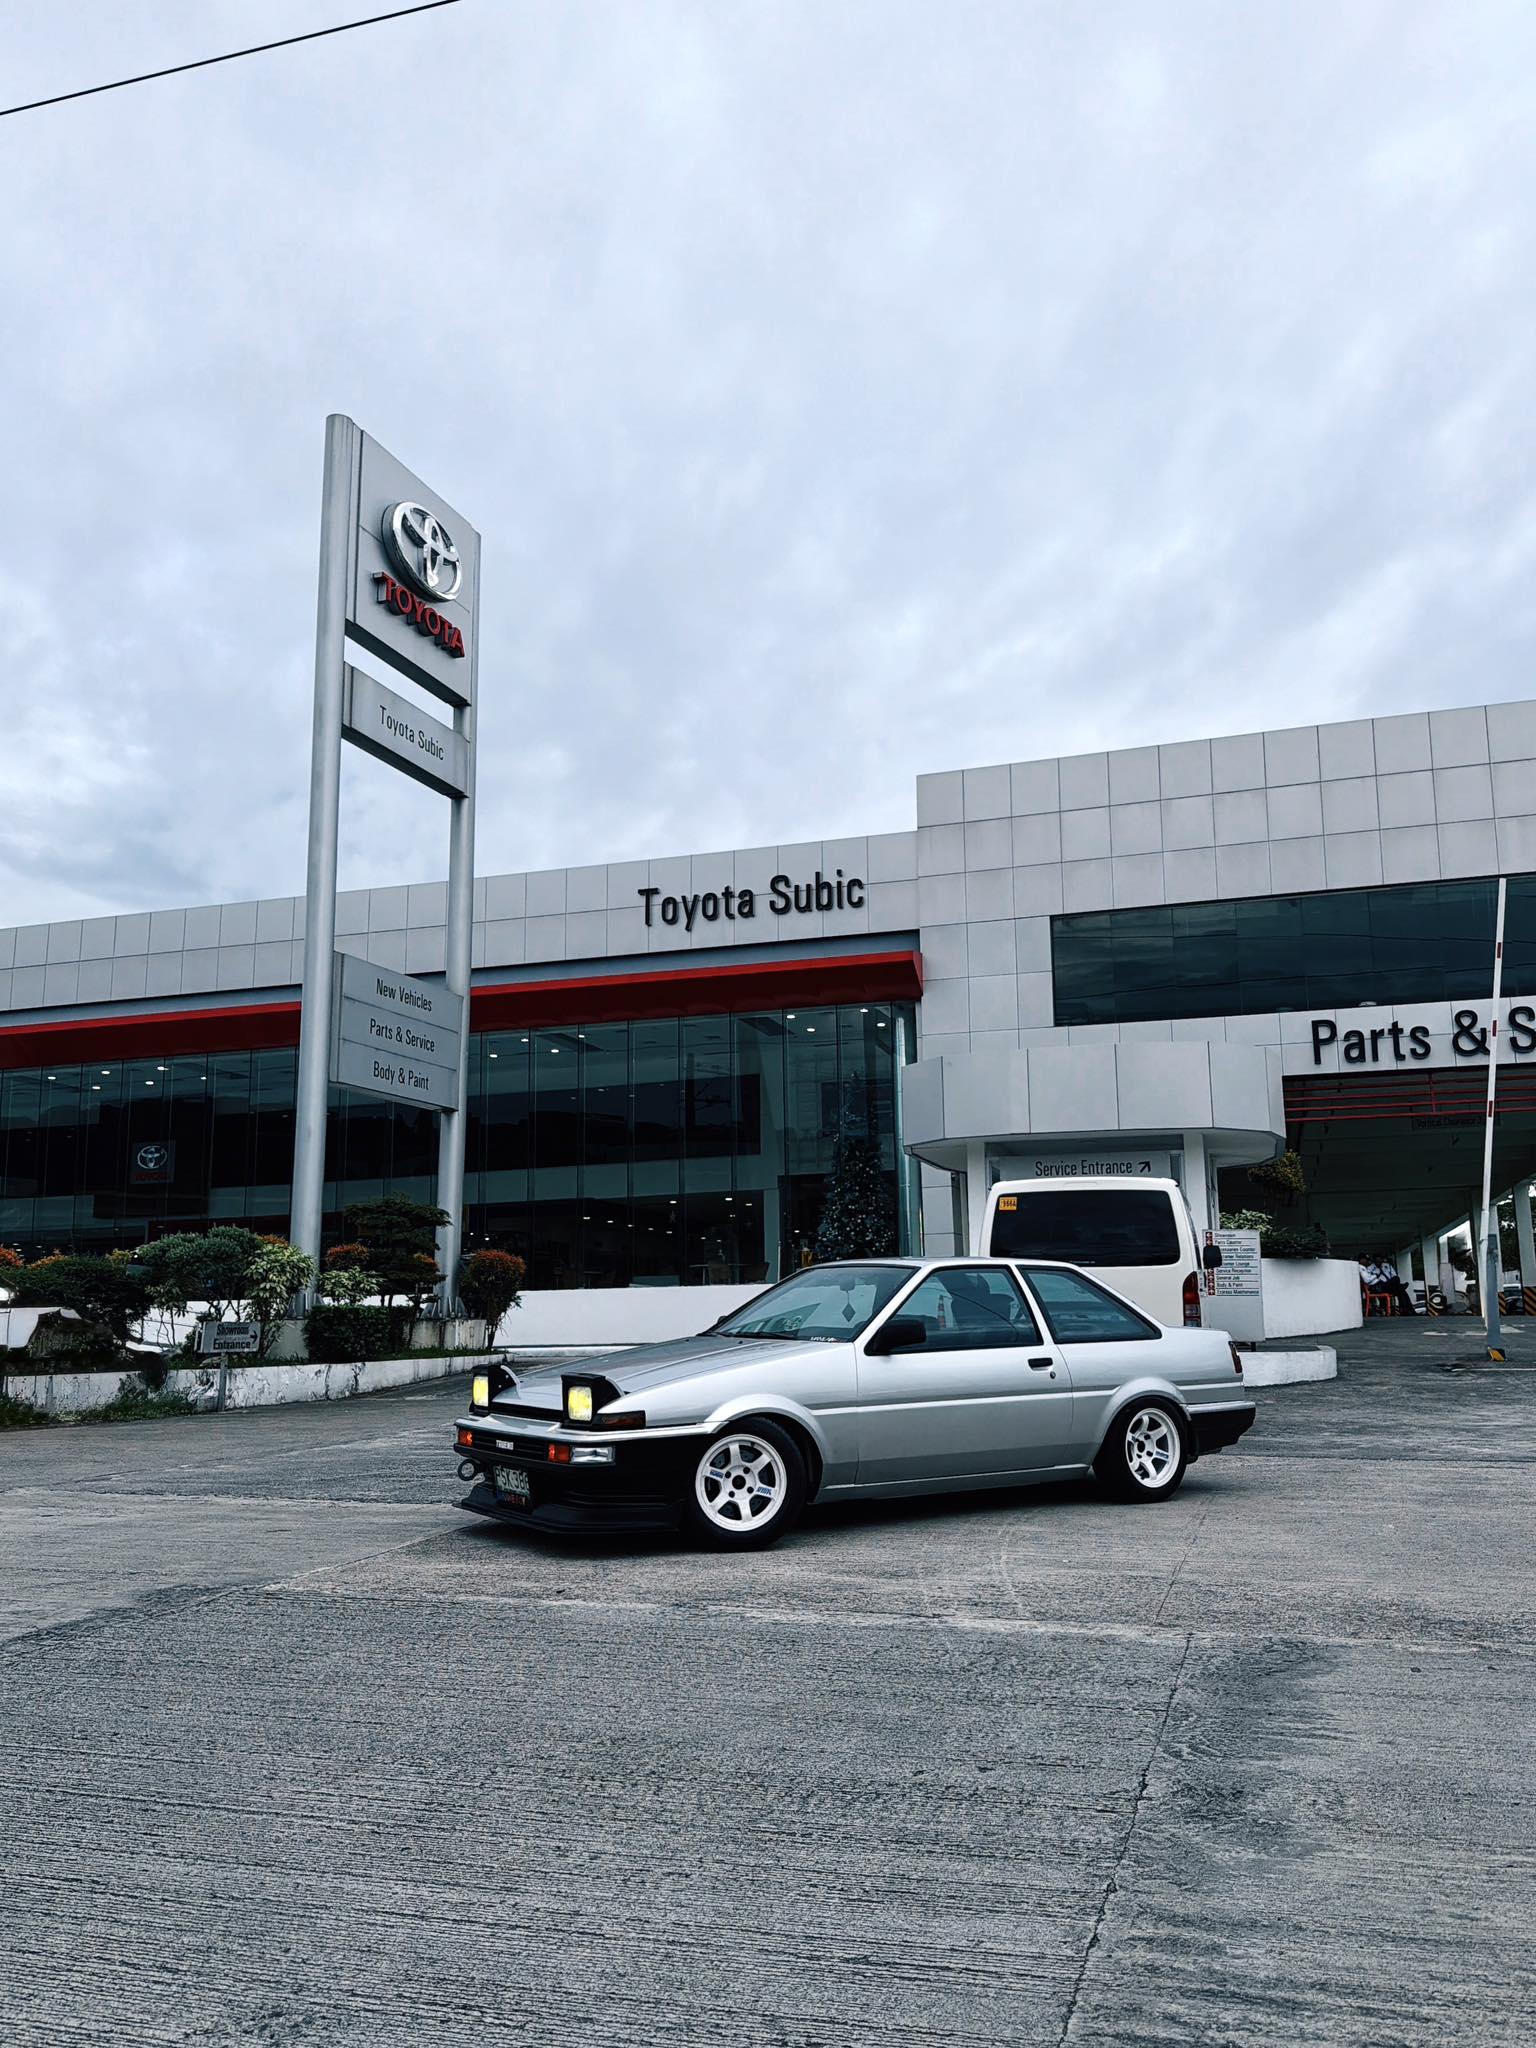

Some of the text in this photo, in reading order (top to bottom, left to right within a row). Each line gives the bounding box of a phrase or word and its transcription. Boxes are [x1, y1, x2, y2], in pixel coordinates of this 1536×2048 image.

[373, 571, 465, 658] TOYOTA
[379, 705, 444, 761] Toyota Subic
[637, 869, 864, 932] Toyota Subic
[376, 978, 432, 1012] New Vehicles
[370, 1018, 435, 1052] Parts & Service
[1311, 1019, 1431, 1065] Parts
[1452, 1009, 1491, 1057] &
[373, 1060, 429, 1090] Body & Paint
[1035, 1160, 1133, 1176] Service Entrance
[213, 1338, 251, 1350] Entrance
[217, 1323, 249, 1335] Showroom
